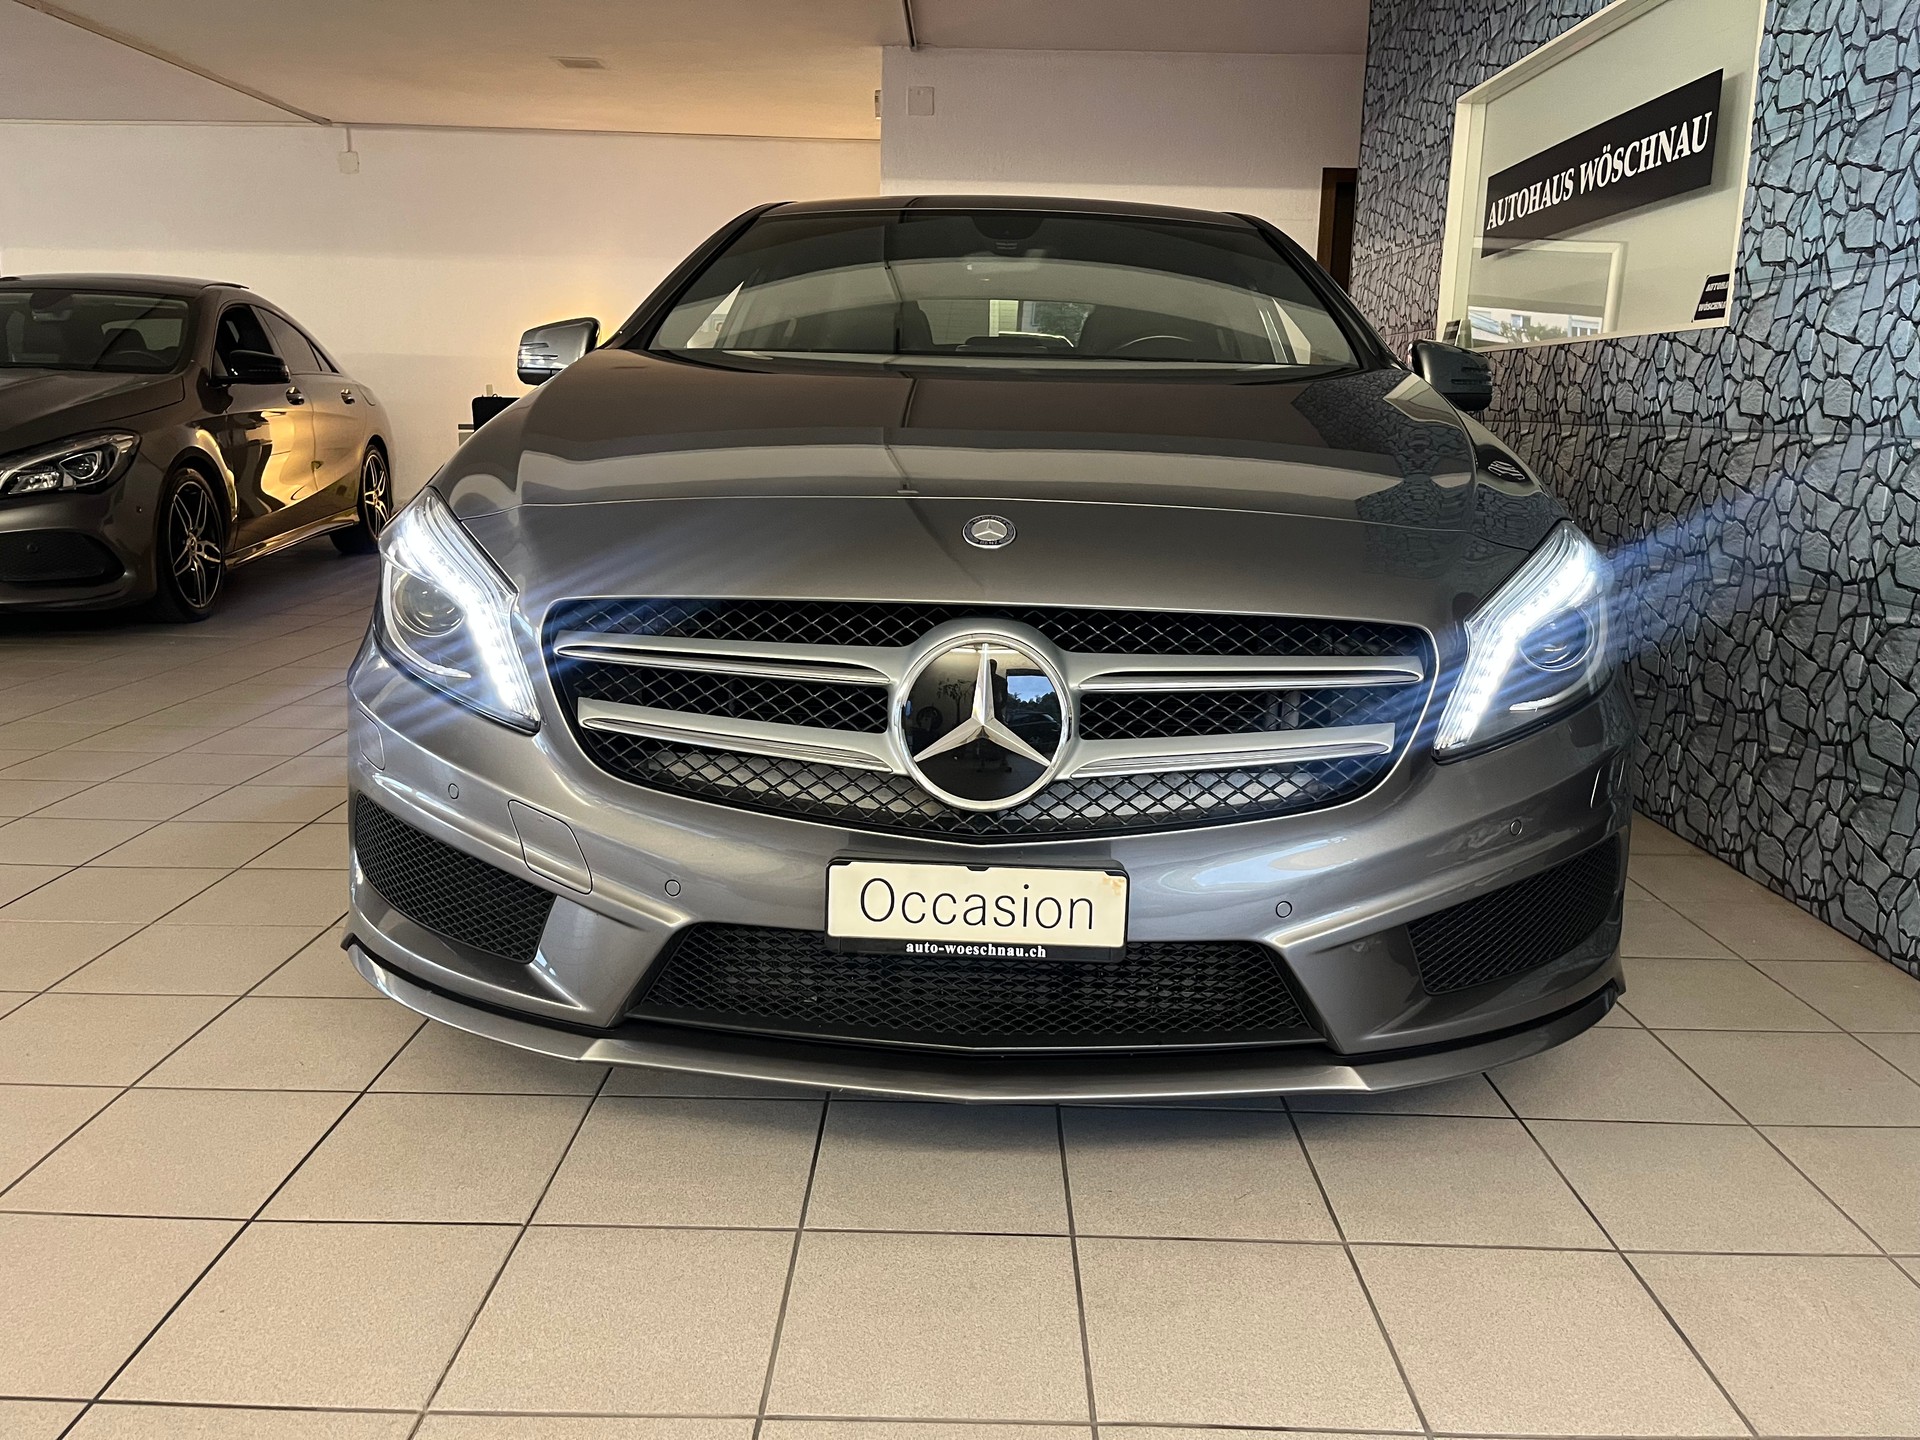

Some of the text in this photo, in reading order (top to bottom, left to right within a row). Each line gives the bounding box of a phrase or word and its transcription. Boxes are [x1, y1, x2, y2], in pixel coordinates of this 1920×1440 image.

[1486, 111, 1713, 231] AUTOHAUS WÖSCHNAU
[860, 877, 1093, 930] Occasion
[905, 941, 1047, 958] auto-woeschnau.ch
